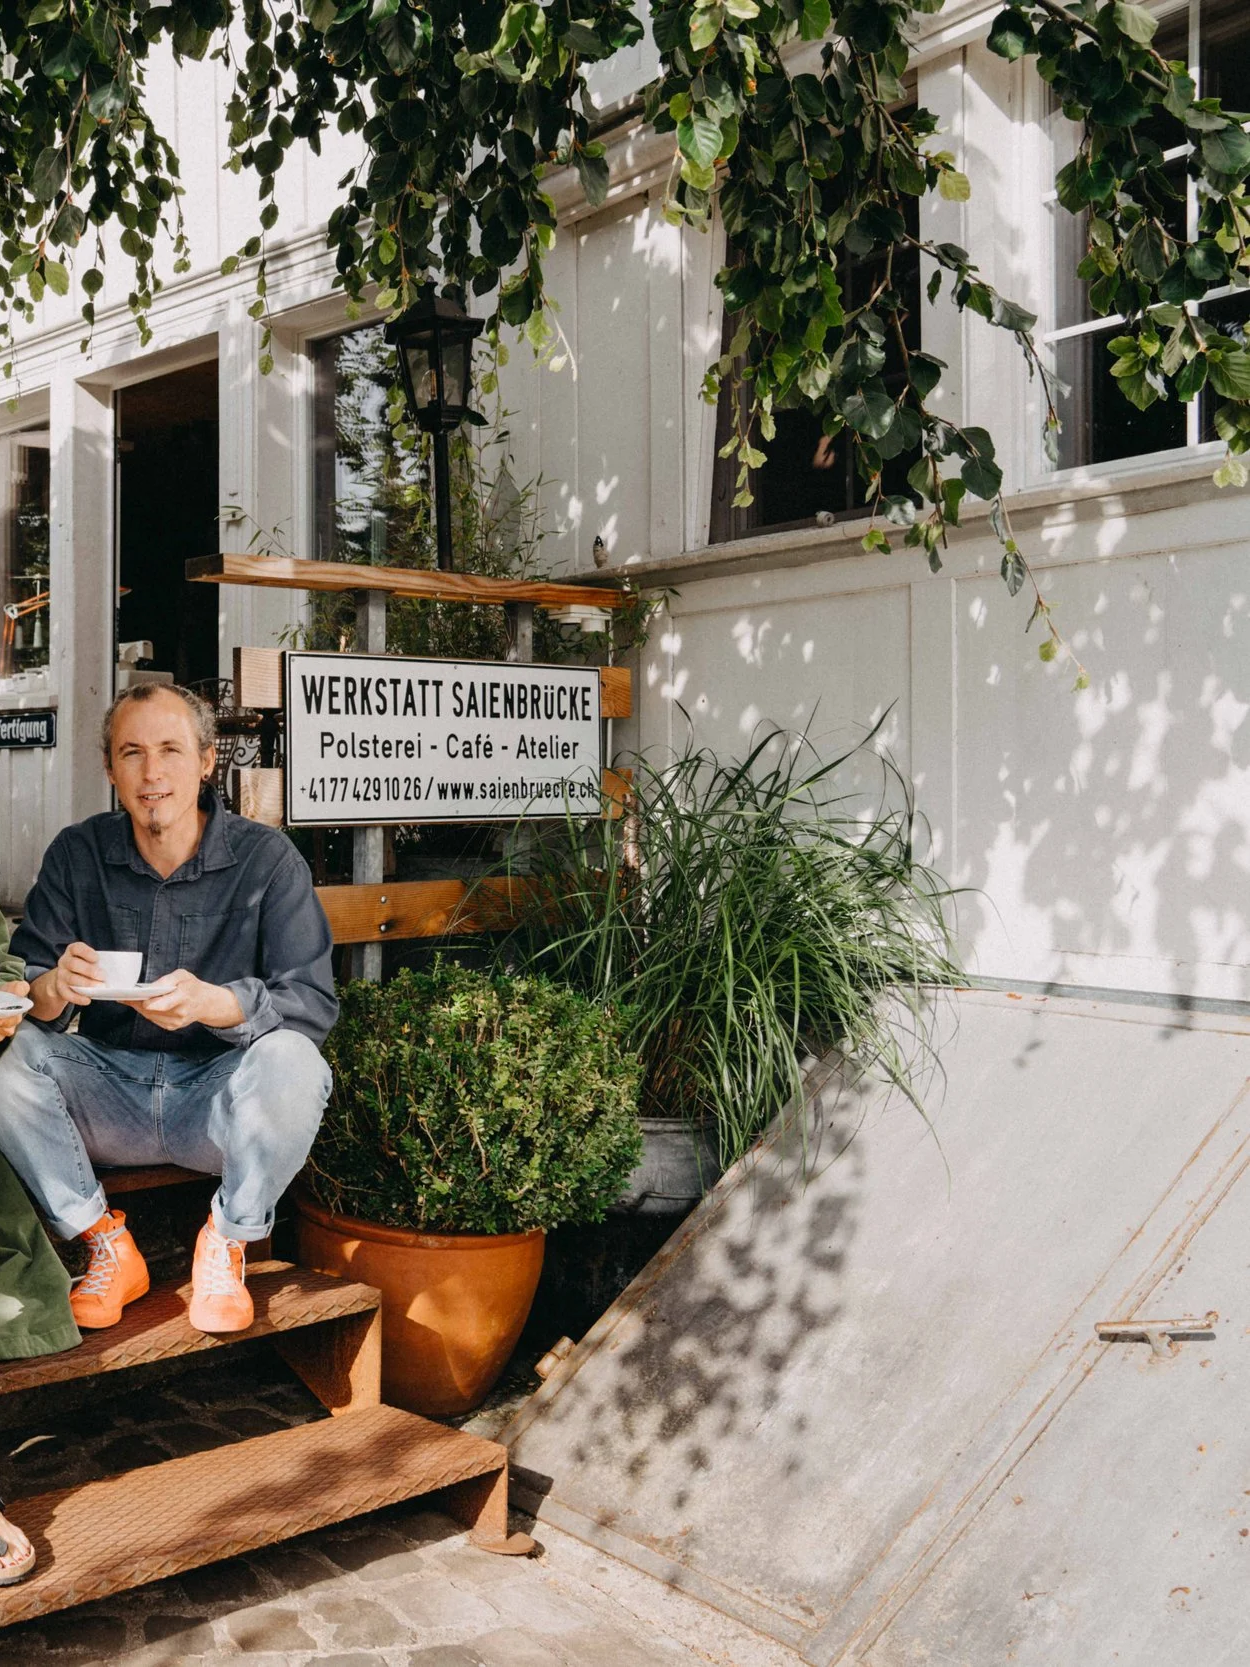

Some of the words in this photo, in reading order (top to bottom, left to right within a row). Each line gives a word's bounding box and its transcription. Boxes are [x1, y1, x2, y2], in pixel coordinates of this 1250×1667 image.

[301, 675, 443, 716] WERKSTATT
[452, 681, 592, 721] SAIENBRÜCKE
[320, 732, 422, 759] Polsterei
[447, 734, 493, 759] Café
[516, 735, 580, 759] Atelier
